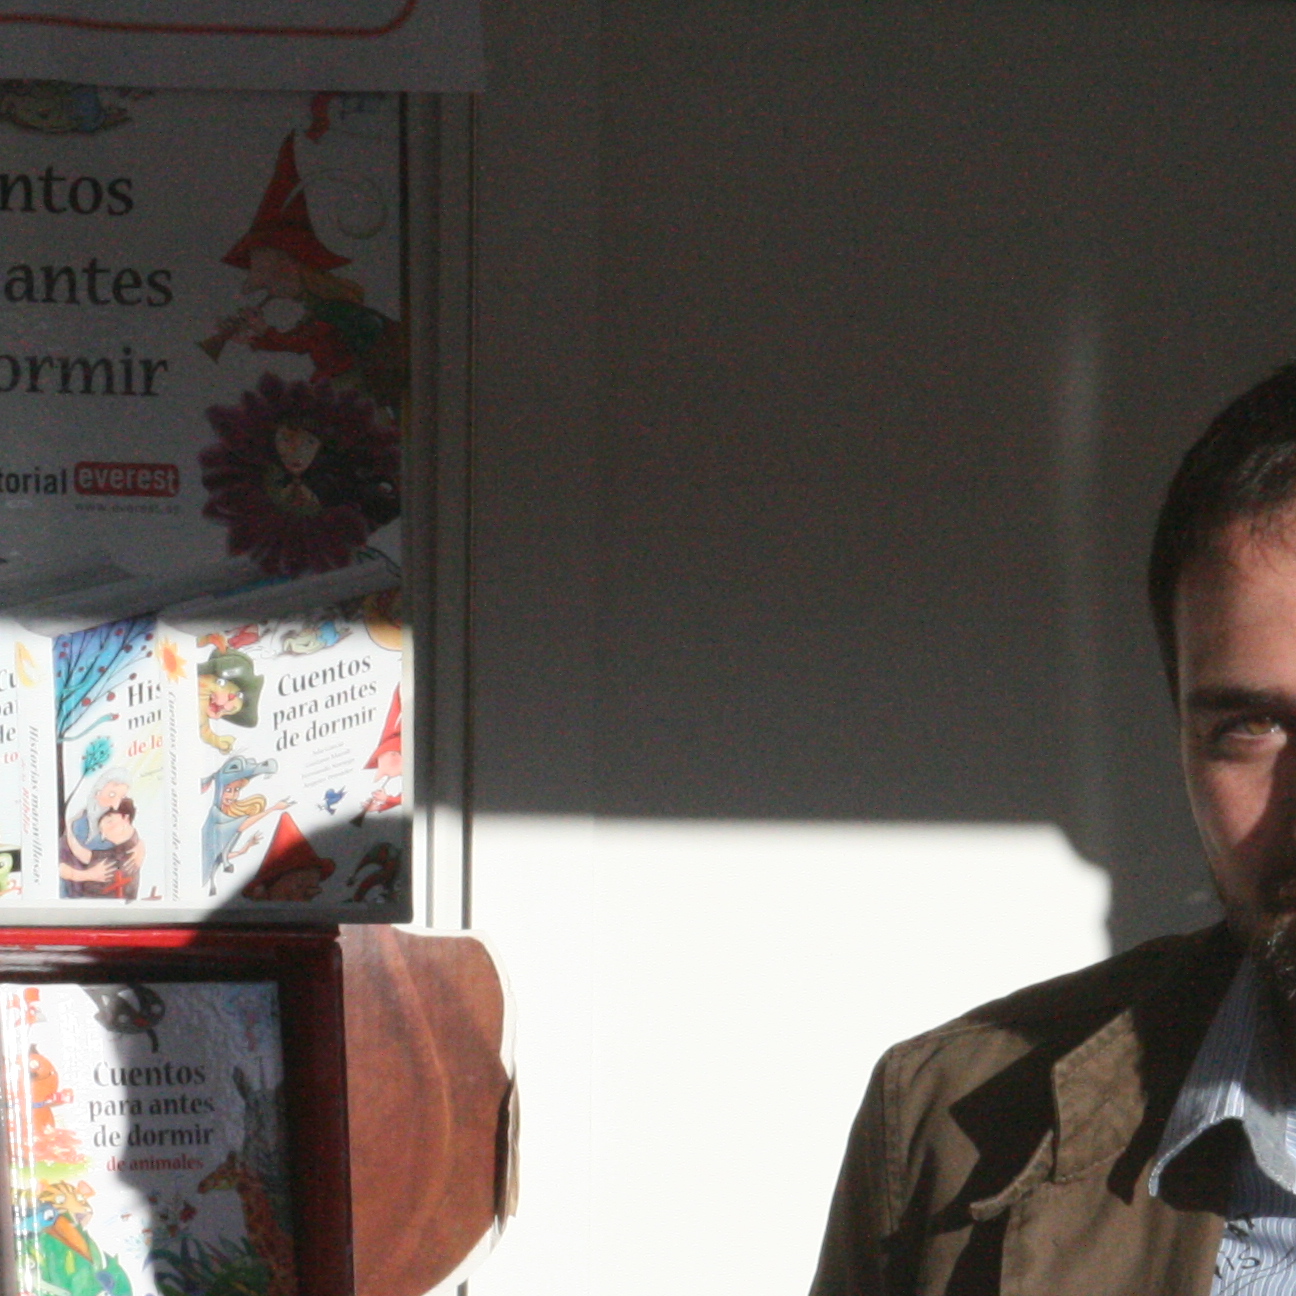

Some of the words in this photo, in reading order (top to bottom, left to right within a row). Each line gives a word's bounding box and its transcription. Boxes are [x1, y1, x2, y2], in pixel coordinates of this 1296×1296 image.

[4, 257, 173, 308] antes
[78, 467, 178, 492] everest
[277, 655, 373, 698] Cuentos
[167, 691, 179, 750] Cuentos
[272, 692, 320, 731] para
[323, 679, 379, 710] antes
[274, 726, 302, 754] de
[304, 704, 379, 743] dormir
[28, 725, 40, 790] Historias
[168, 750, 180, 786] para
[29, 793, 42, 885] maravillosas
[93, 1059, 207, 1088] Cuentos
[89, 1097, 145, 1122] para
[149, 1094, 217, 1116] antes
[94, 1123, 121, 1147] de
[126, 1122, 215, 1147] dormir
[106, 1155, 127, 1173] de
[129, 1154, 204, 1173] animales
